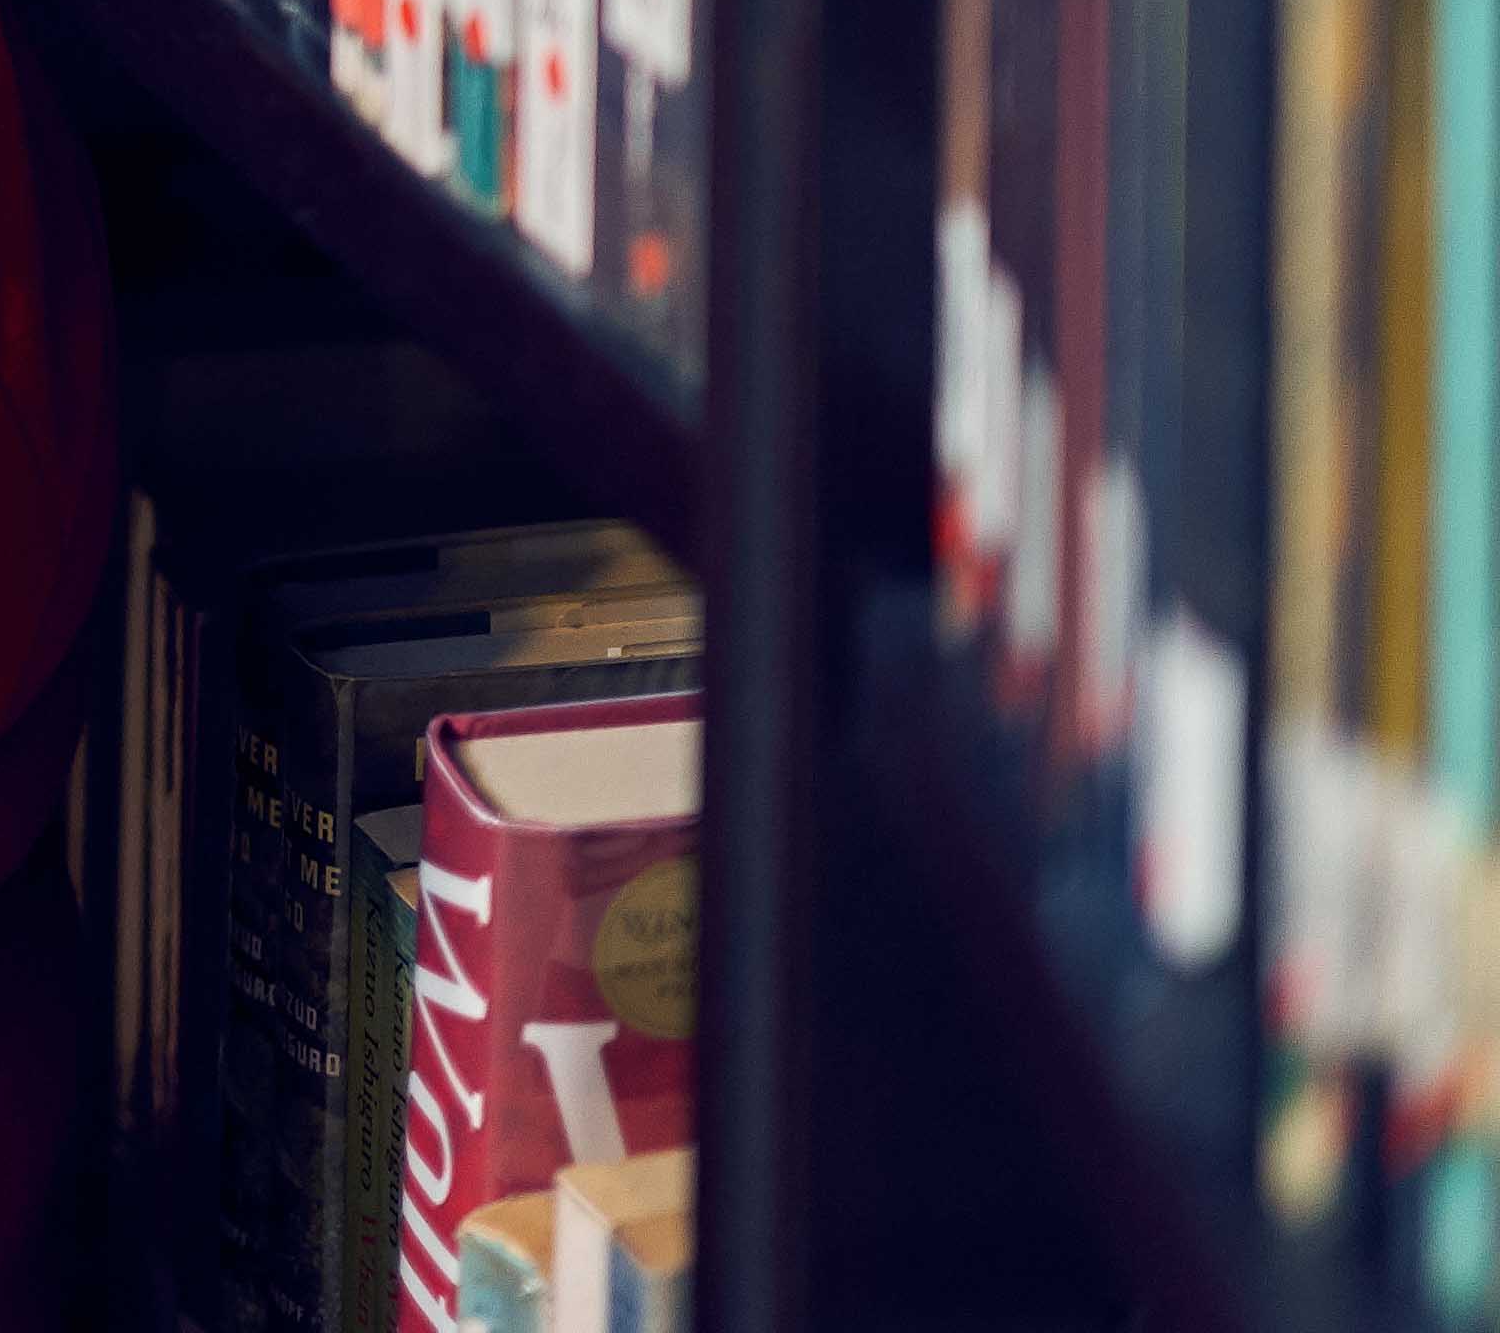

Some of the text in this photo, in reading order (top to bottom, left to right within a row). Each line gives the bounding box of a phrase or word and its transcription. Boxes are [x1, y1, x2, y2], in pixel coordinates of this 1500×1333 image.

[237, 724, 277, 776] VER
[247, 785, 282, 829] ME
[290, 790, 334, 844] VER
[301, 852, 342, 896] ME
[364, 895, 383, 1019] Kazuo
[358, 1026, 380, 1192] Ishiguro
